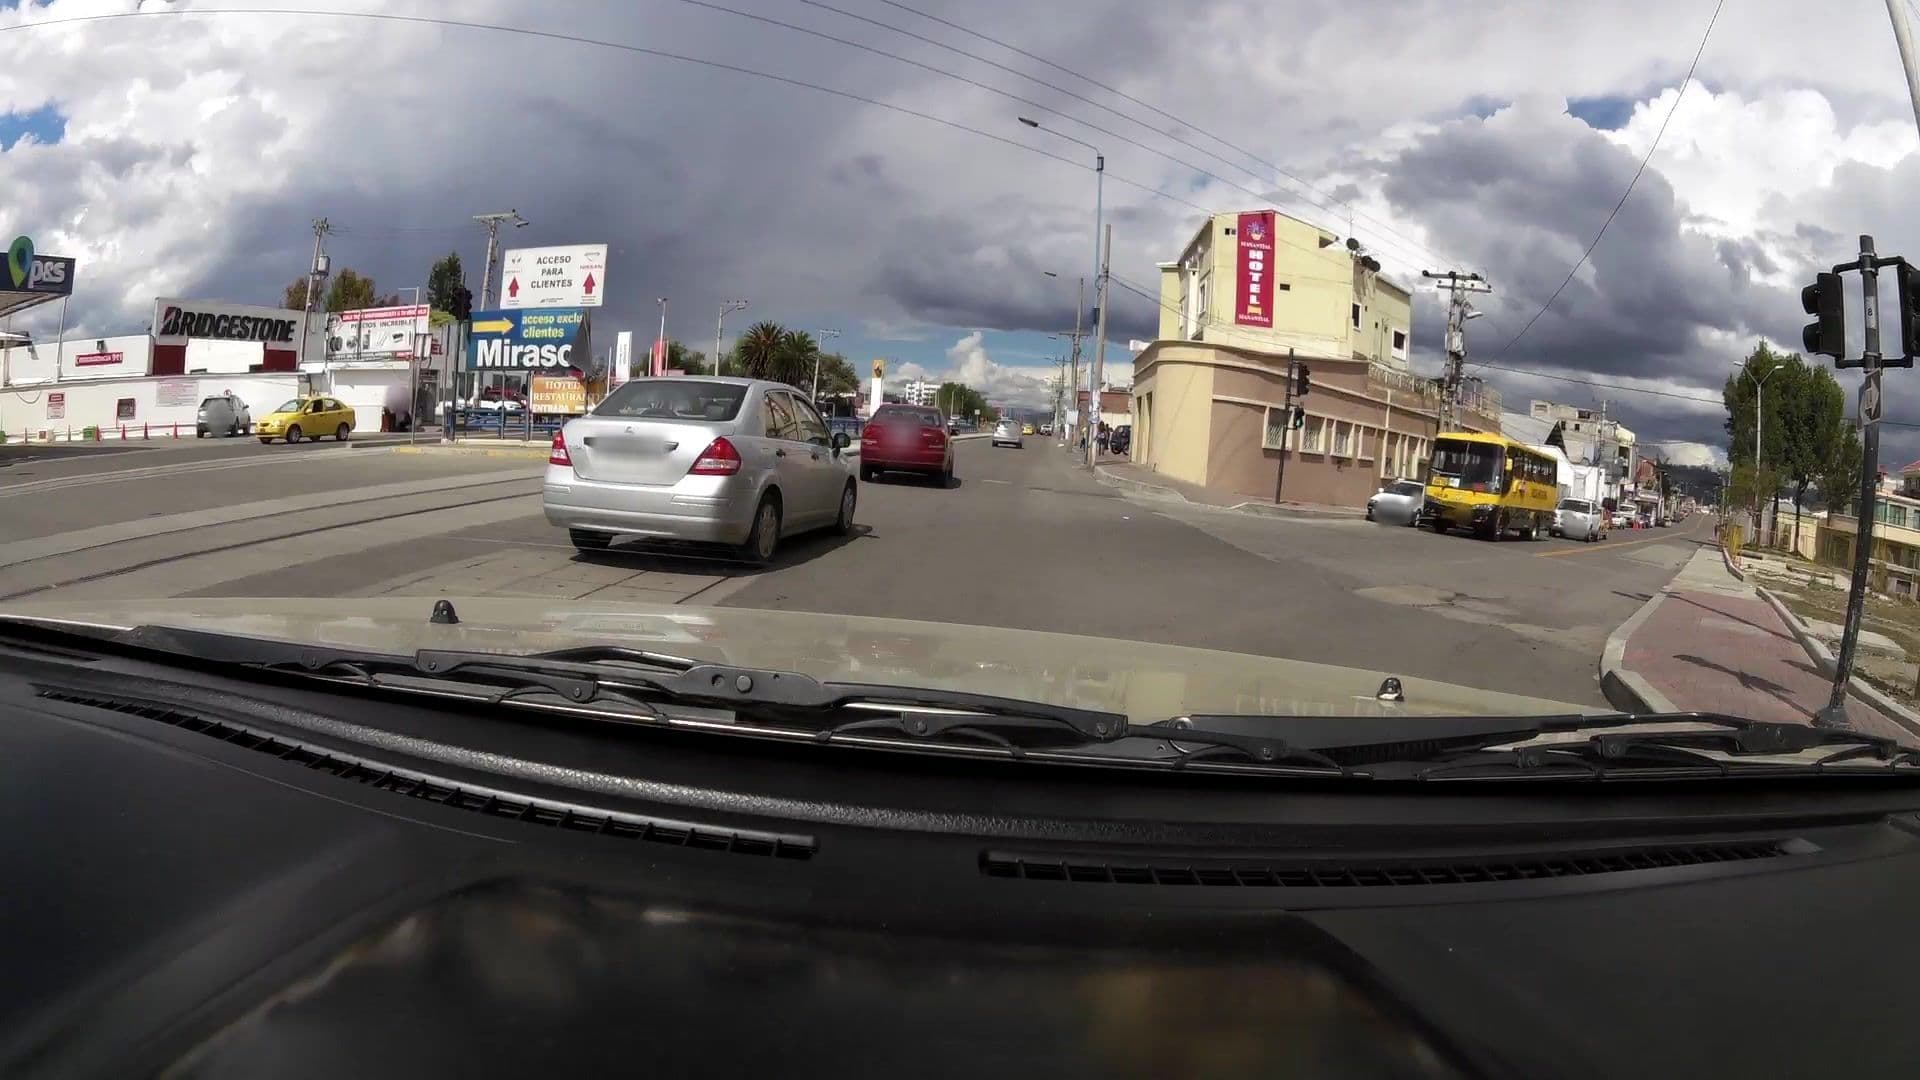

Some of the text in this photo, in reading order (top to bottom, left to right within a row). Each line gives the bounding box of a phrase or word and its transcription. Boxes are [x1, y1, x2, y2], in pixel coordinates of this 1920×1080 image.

[537, 256, 571, 265] ACCESO
[541, 267, 564, 276] PARA
[1249, 249, 1264, 305] HOTEL
[531, 279, 573, 289] CLIENTES
[160, 306, 296, 342] BRIDGESTONE
[522, 315, 555, 325] acceso
[523, 325, 565, 339] clientes
[546, 381, 581, 390] HOTEL
